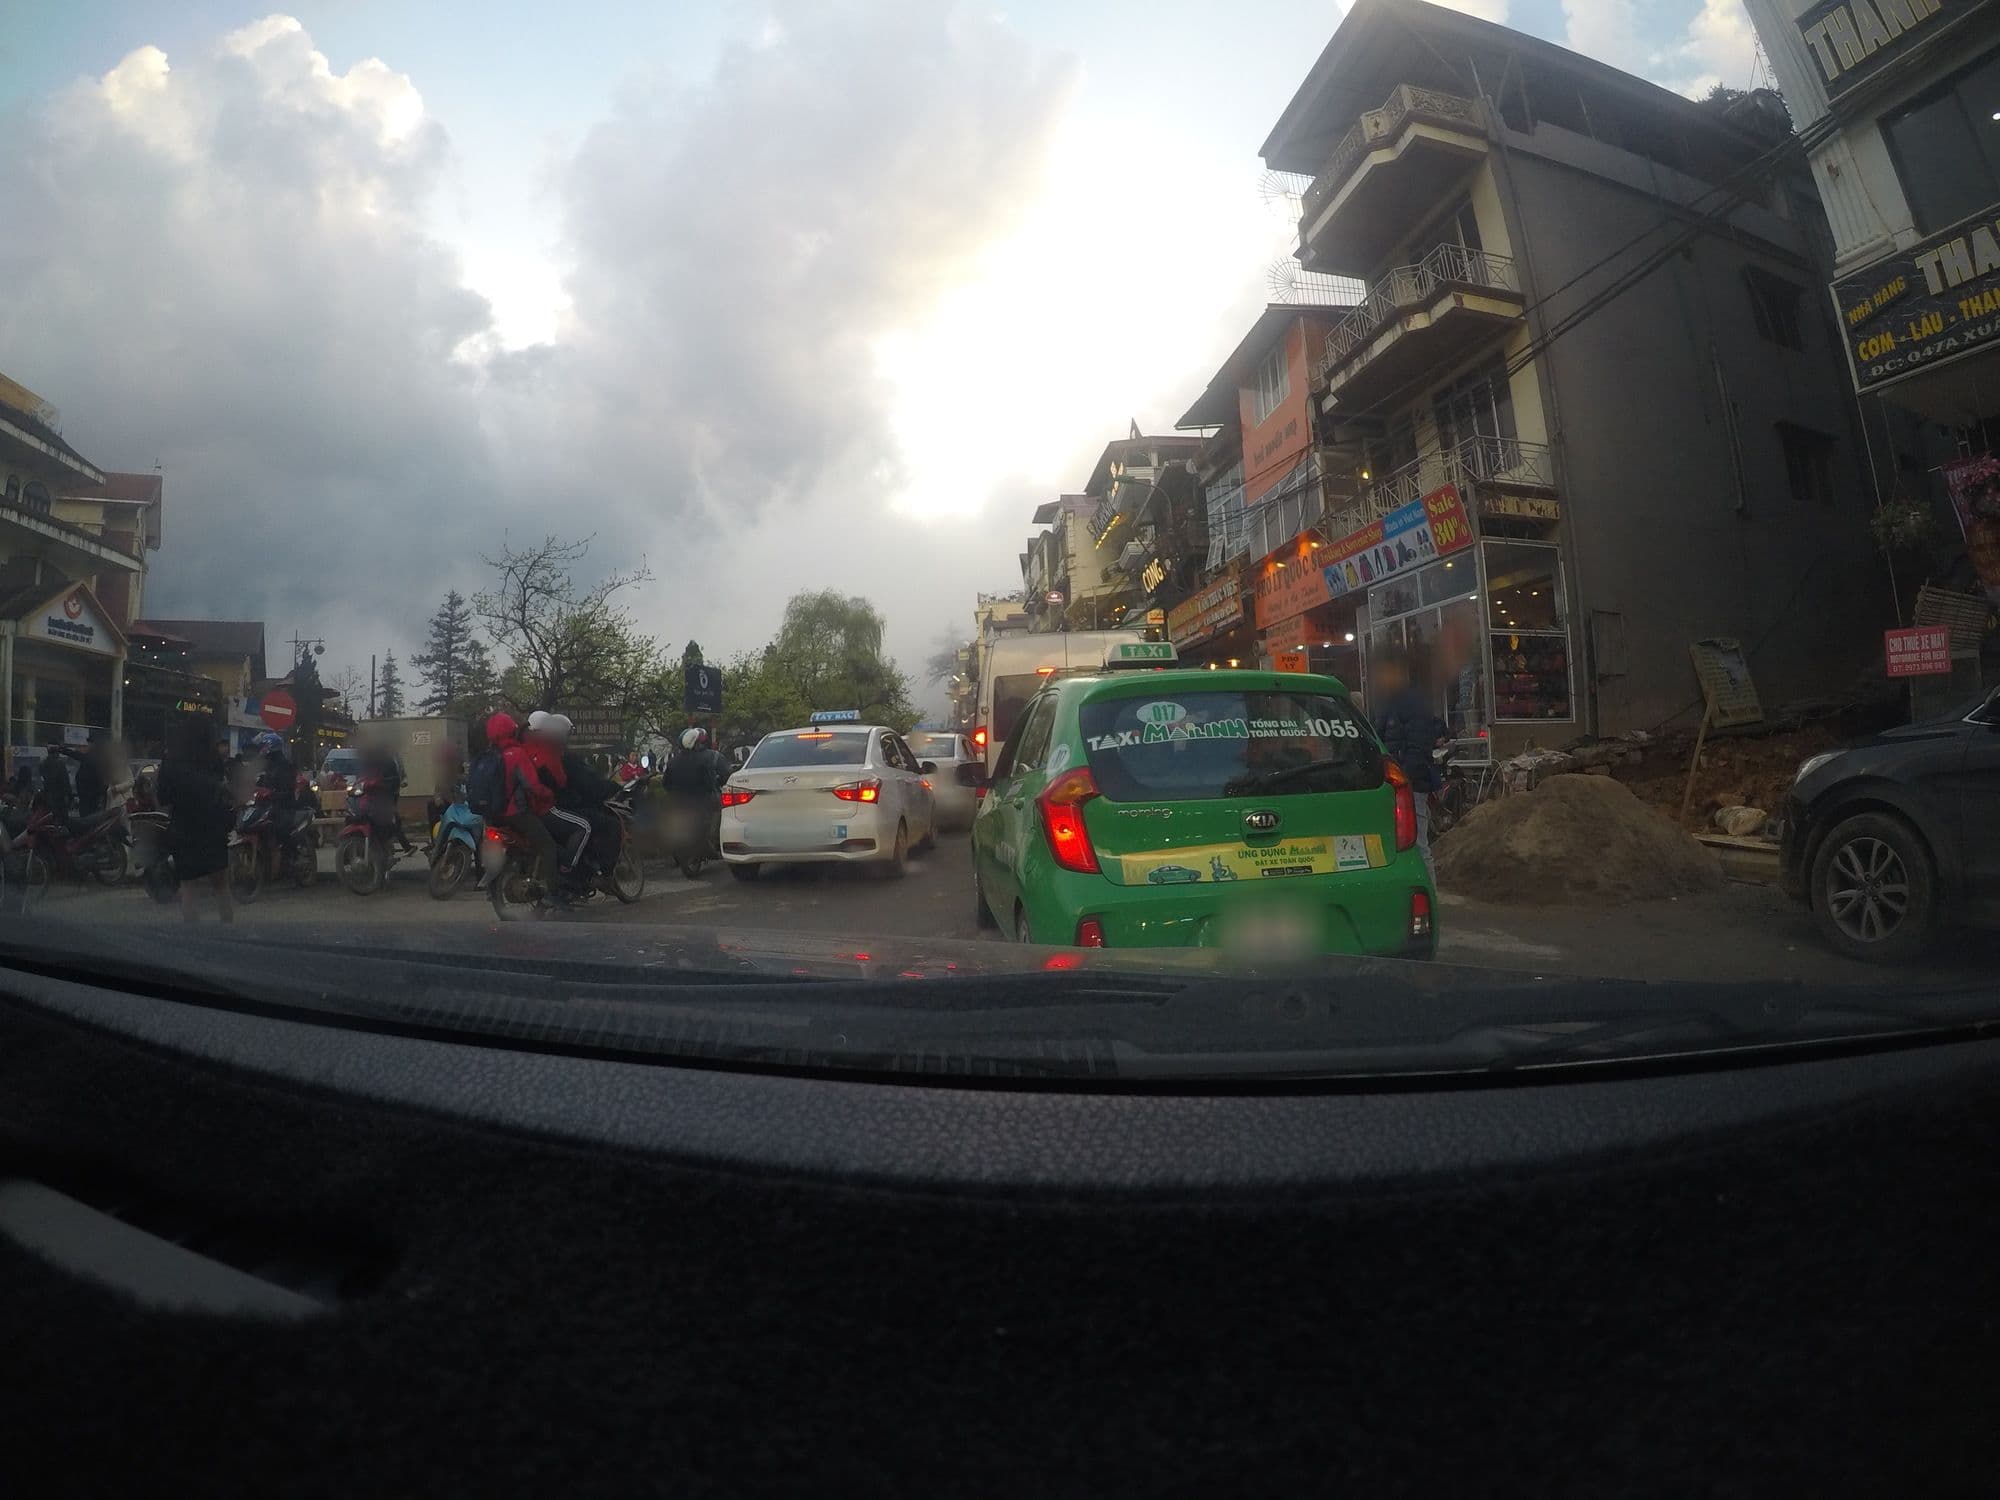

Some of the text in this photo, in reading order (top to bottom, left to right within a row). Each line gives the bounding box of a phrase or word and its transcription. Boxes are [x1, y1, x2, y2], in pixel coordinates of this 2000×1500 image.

[1804, 0, 1943, 81] THAN
[1428, 494, 1456, 517] Sale
[1434, 516, 1468, 545] 30%
[1305, 718, 1359, 739] 1055
[1252, 815, 1276, 827] KIA
